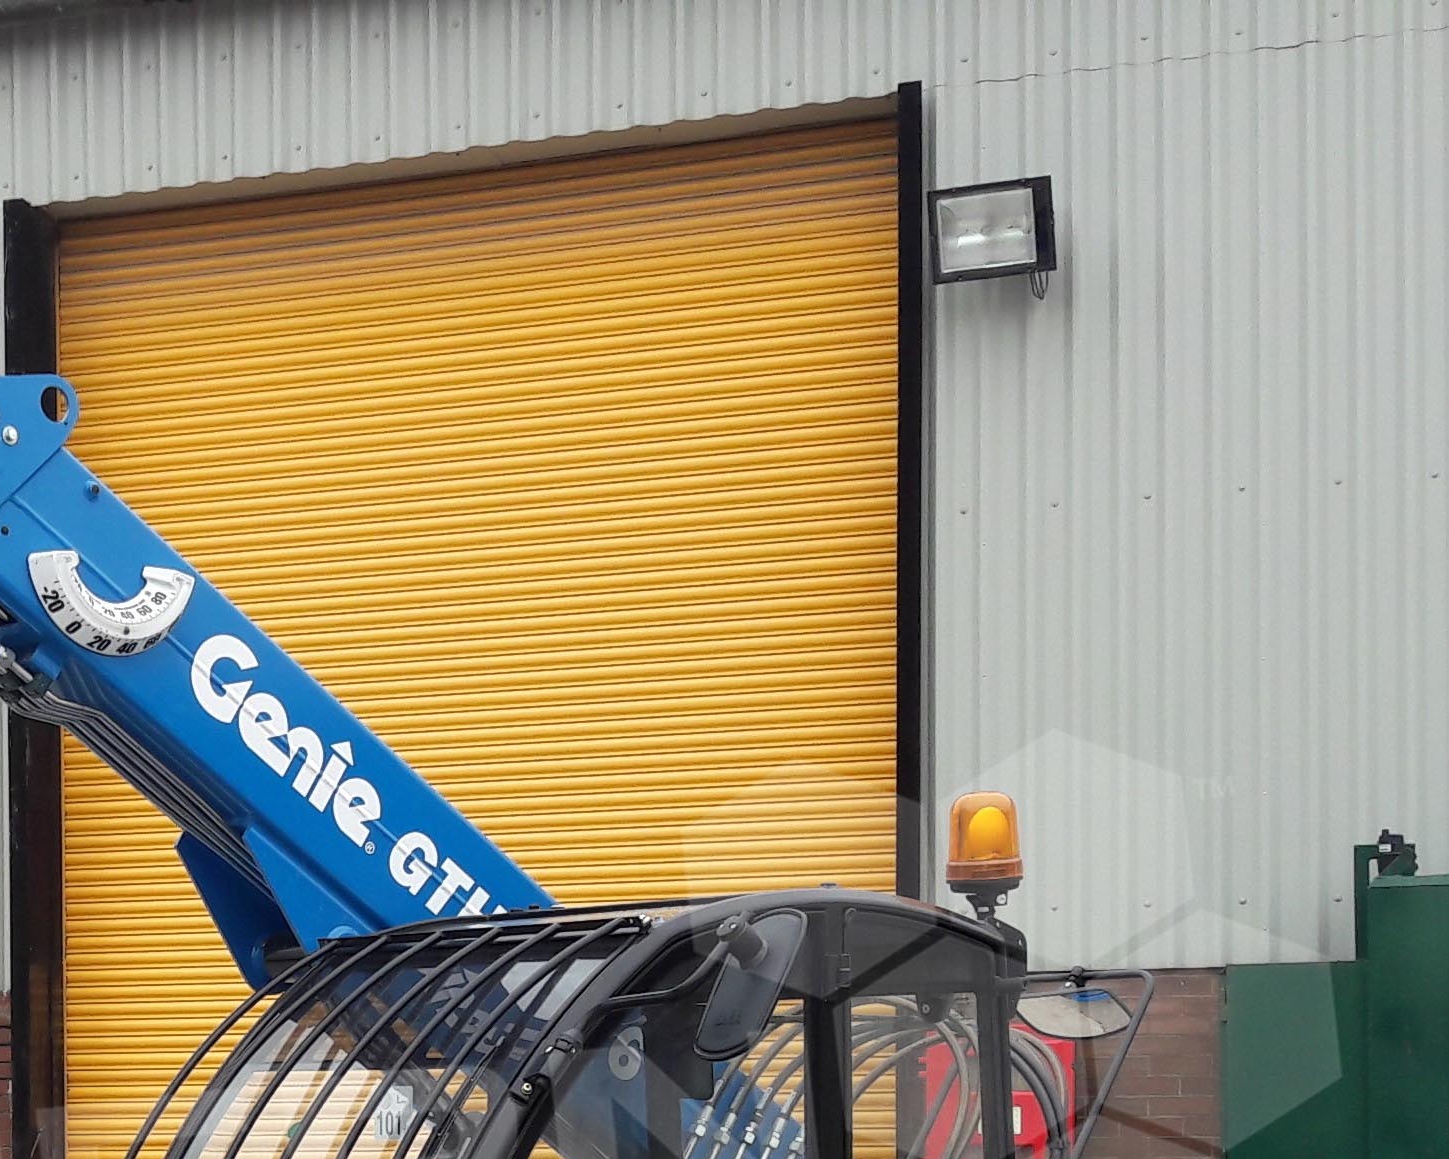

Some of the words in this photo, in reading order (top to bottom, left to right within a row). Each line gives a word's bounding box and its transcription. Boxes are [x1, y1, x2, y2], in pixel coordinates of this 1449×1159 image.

[151, 591, 167, 605] 80
[65, 620, 82, 635] 0
[86, 635, 112, 652] 20
[116, 641, 138, 654] 40
[190, 633, 382, 848] Genie
[377, 1110, 401, 1136] 101
